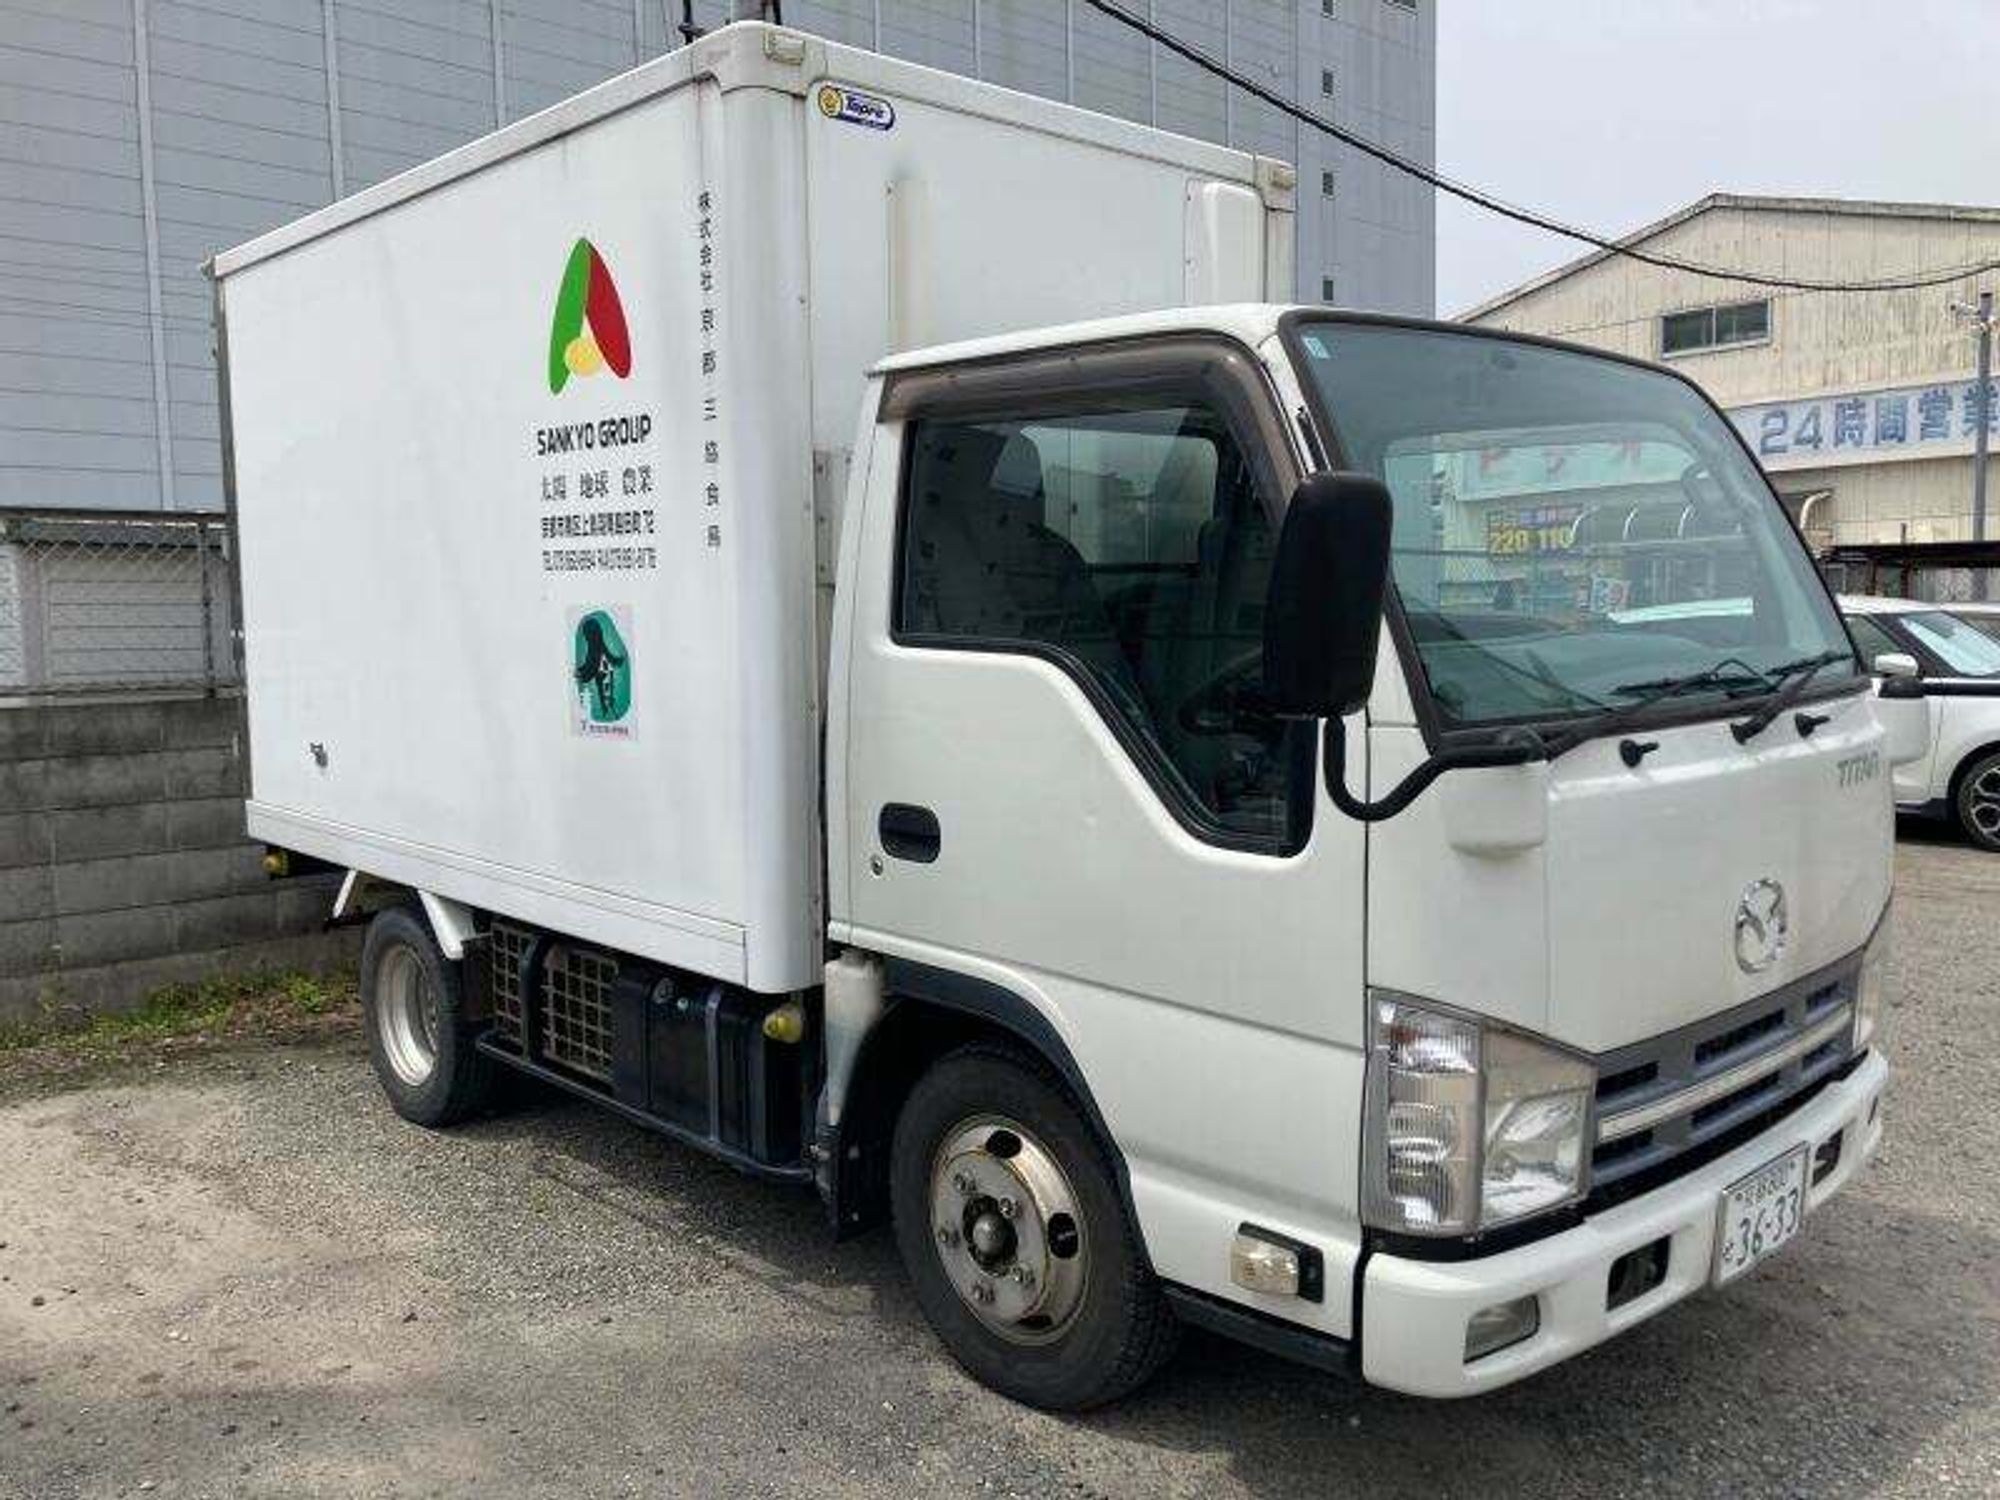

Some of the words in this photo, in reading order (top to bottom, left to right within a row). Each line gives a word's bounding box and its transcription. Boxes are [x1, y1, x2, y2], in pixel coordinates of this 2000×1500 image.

[537, 421, 594, 456] SANKYO
[598, 413, 652, 449] GROUP
[1738, 1187, 1799, 1267] 36-33
